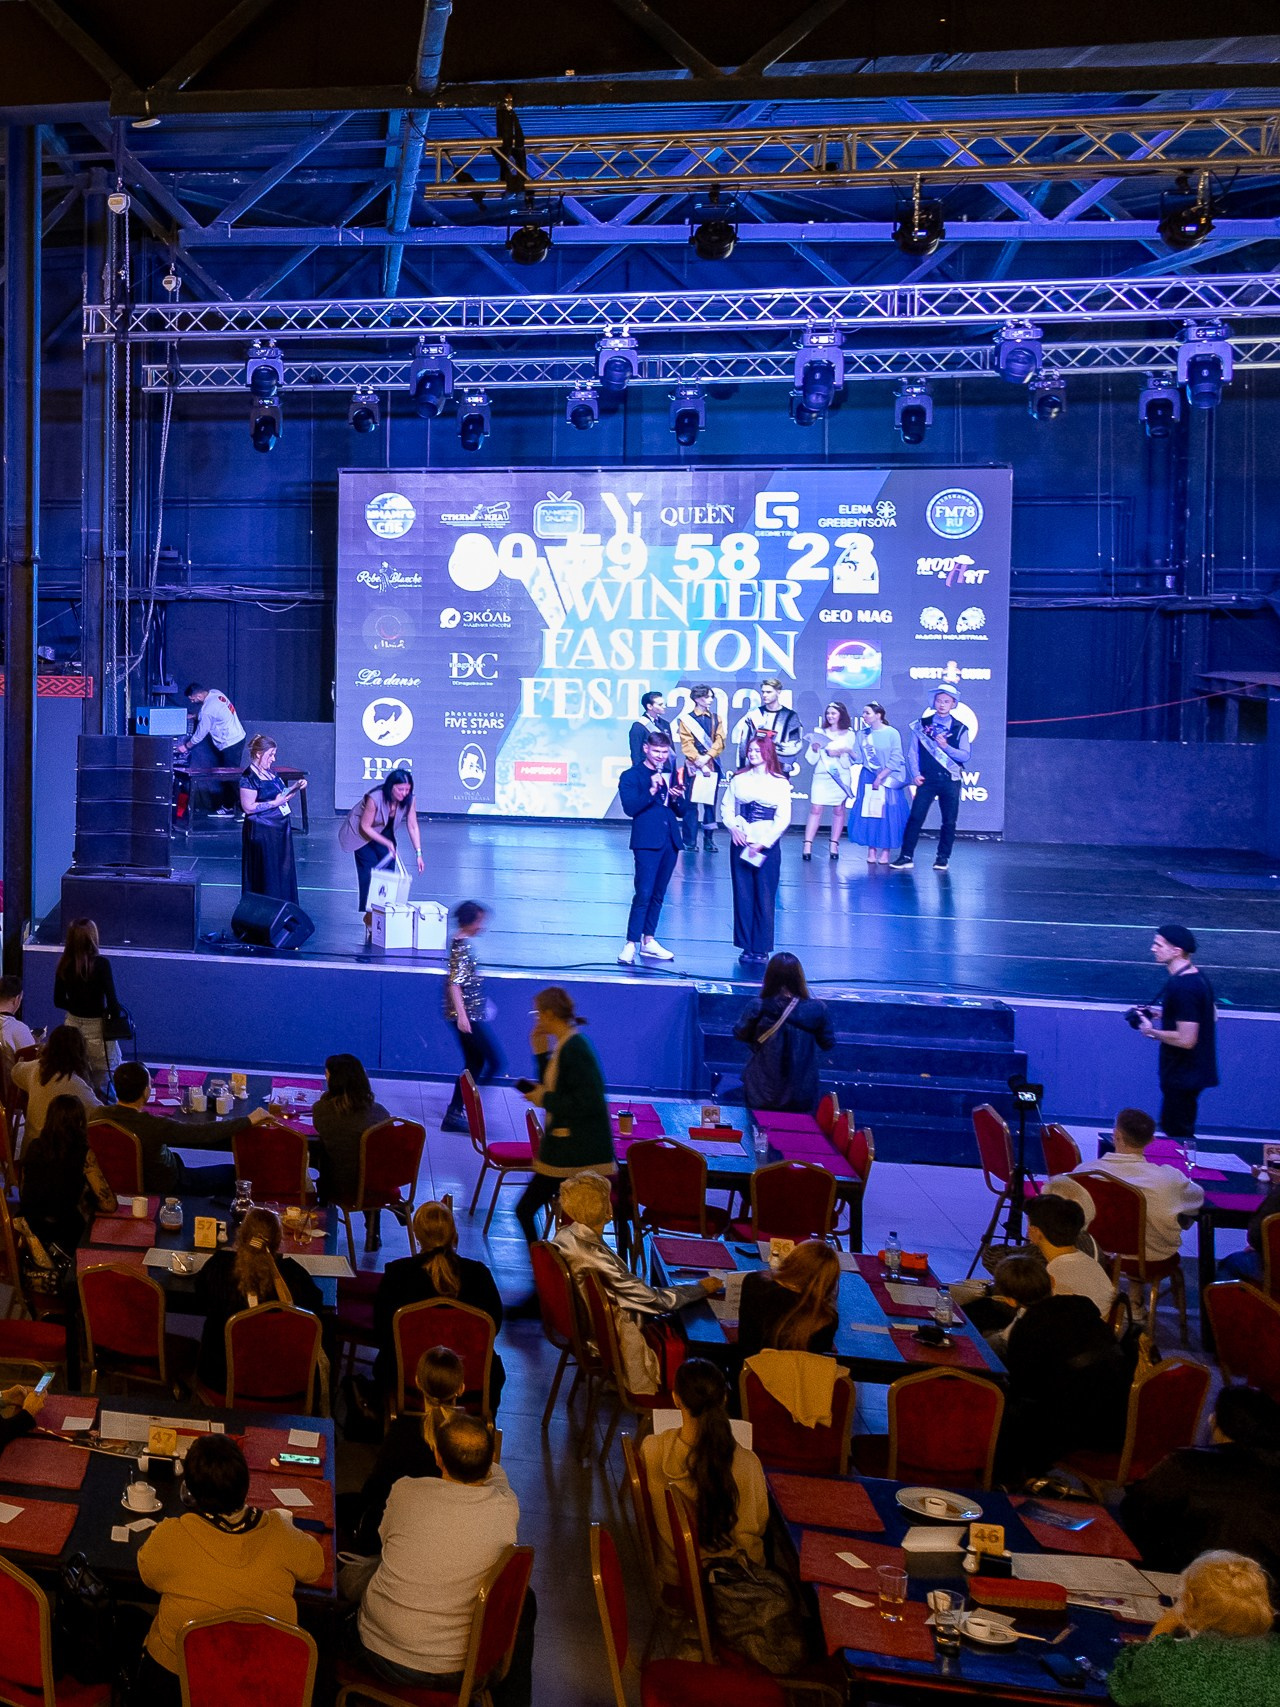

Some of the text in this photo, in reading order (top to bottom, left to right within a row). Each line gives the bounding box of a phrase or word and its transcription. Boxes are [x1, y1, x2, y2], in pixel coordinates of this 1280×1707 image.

[838, 505, 873, 514] ELENA
[935, 505, 976, 518] FM78
[660, 507, 735, 527] QUEEN
[818, 518, 897, 528] GREBENTSOVA
[945, 517, 964, 527] RU
[673, 533, 761, 581] 58
[356, 571, 422, 589] Robe Blanche
[566, 573, 805, 627] WINTER
[819, 609, 893, 623] GEO MAG
[540, 624, 800, 680] FASHION
[449, 652, 499, 679] DC
[355, 668, 422, 687] La danse
[910, 667, 944, 680] QUEST
[519, 677, 651, 720] FEST
[444, 710, 505, 718] photostudio
[444, 718, 505, 729] FIVE STARS
[197, 1220, 213, 1230] 57
[773, 1241, 791, 1254] 56
[151, 1431, 173, 1444] 47
[974, 1528, 999, 1543] 46
